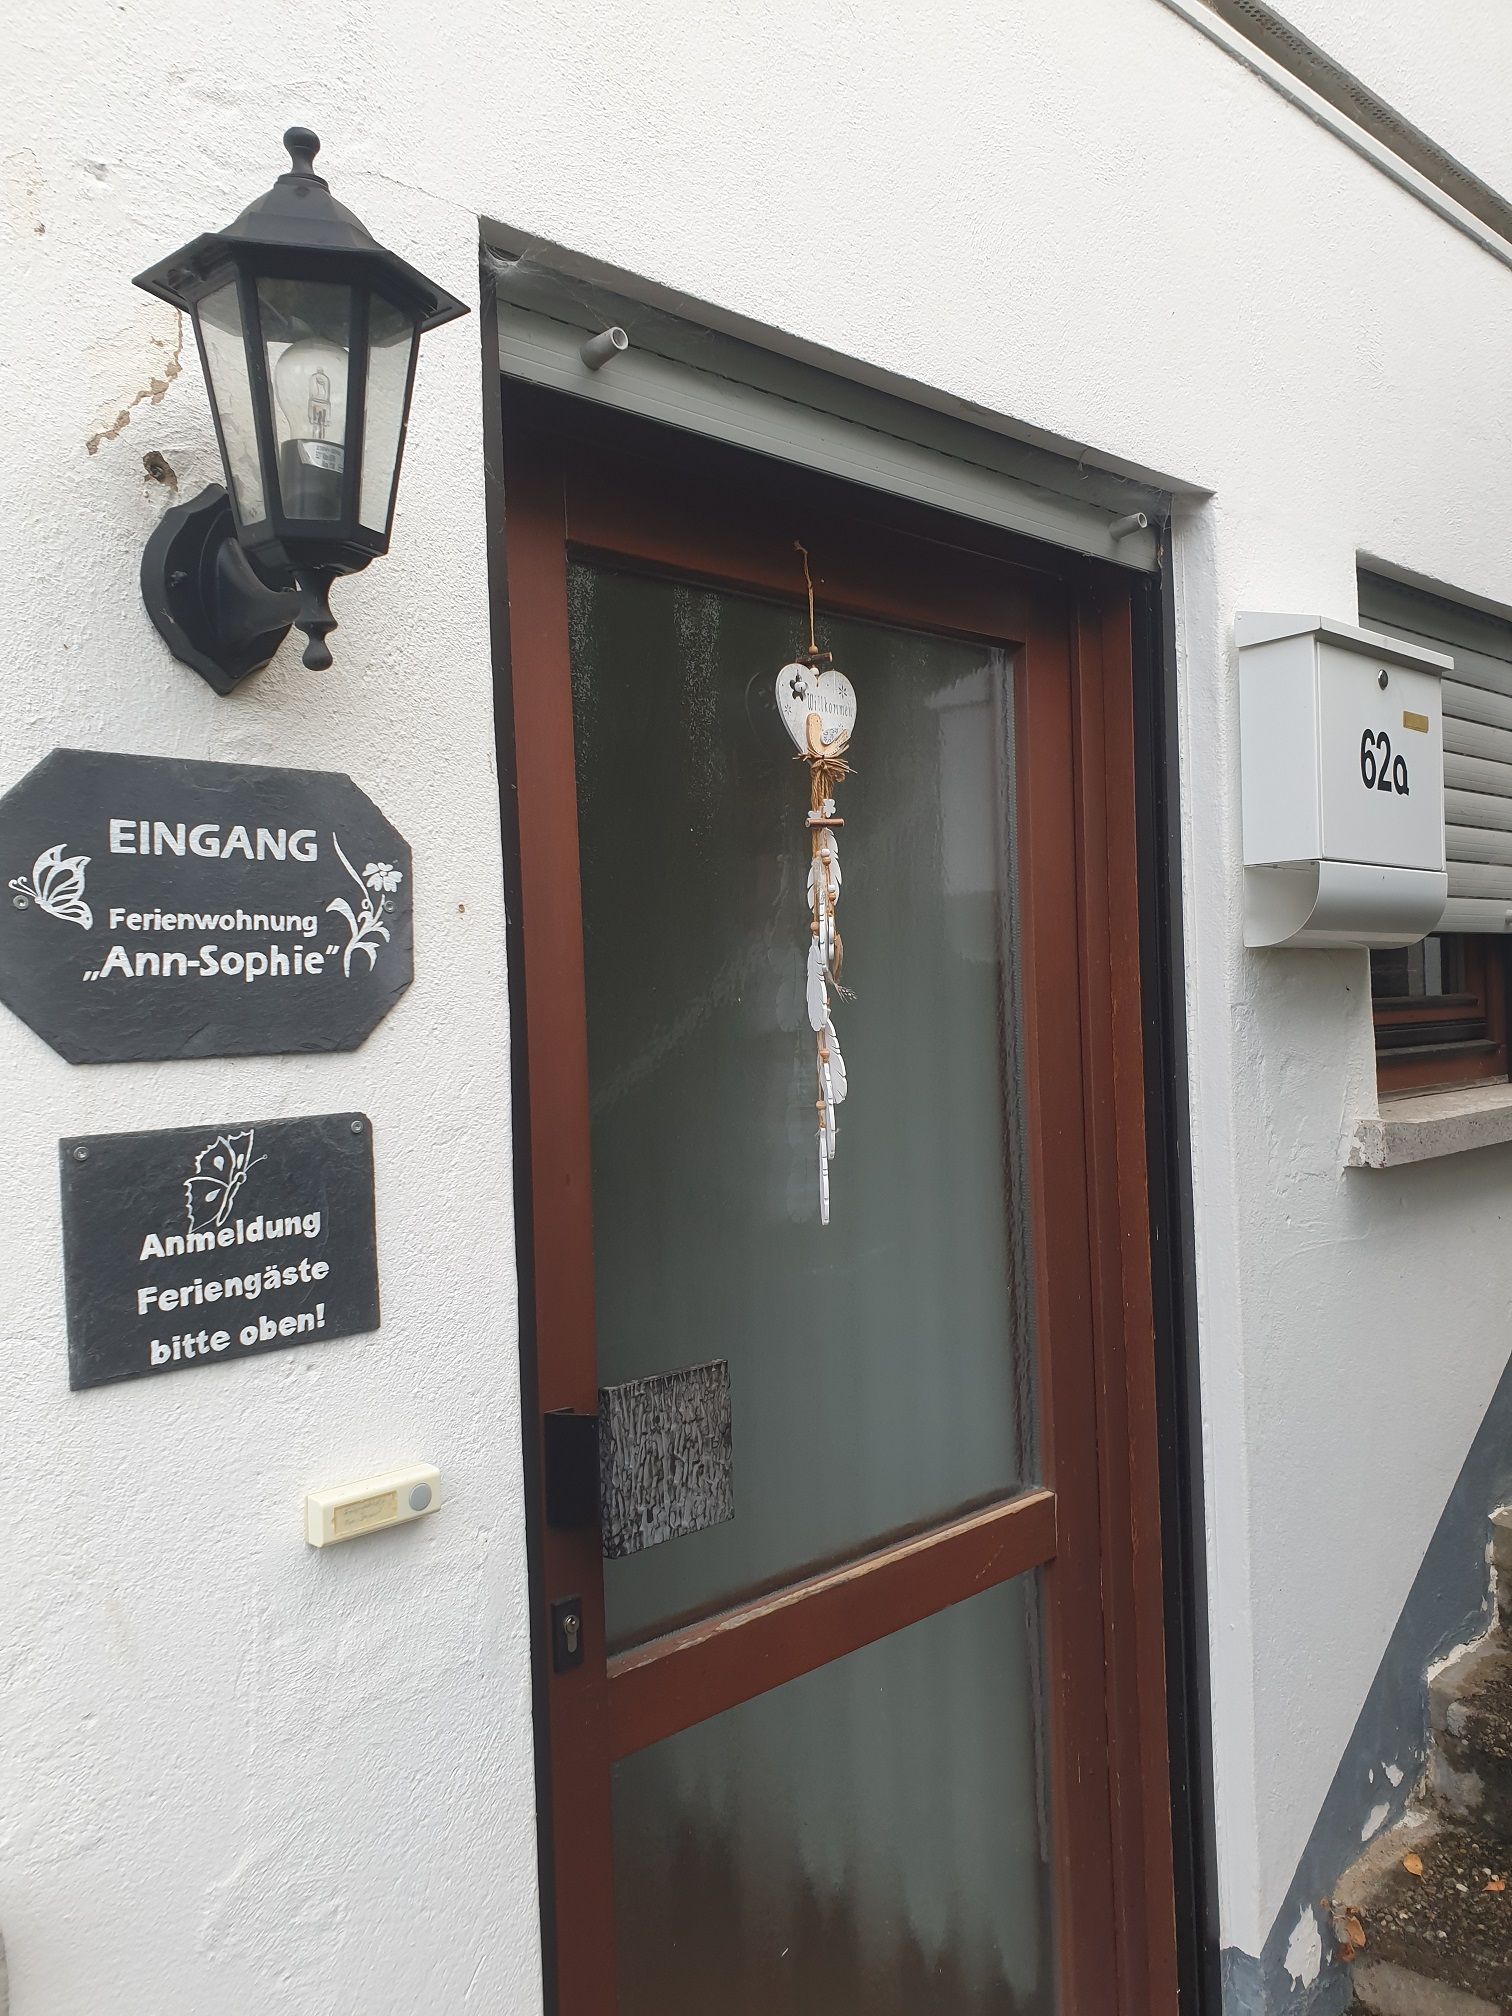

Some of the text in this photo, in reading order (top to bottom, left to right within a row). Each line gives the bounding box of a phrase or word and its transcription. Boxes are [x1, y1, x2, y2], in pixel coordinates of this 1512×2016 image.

[1360, 728, 1410, 796] 62a
[109, 818, 318, 862] EINGANG
[109, 908, 318, 938] Ferienwohnung
[139, 1211, 321, 1261] Anmeldung
[137, 1257, 330, 1315] Feriengäste
[150, 1303, 326, 1366] bitte oben!
